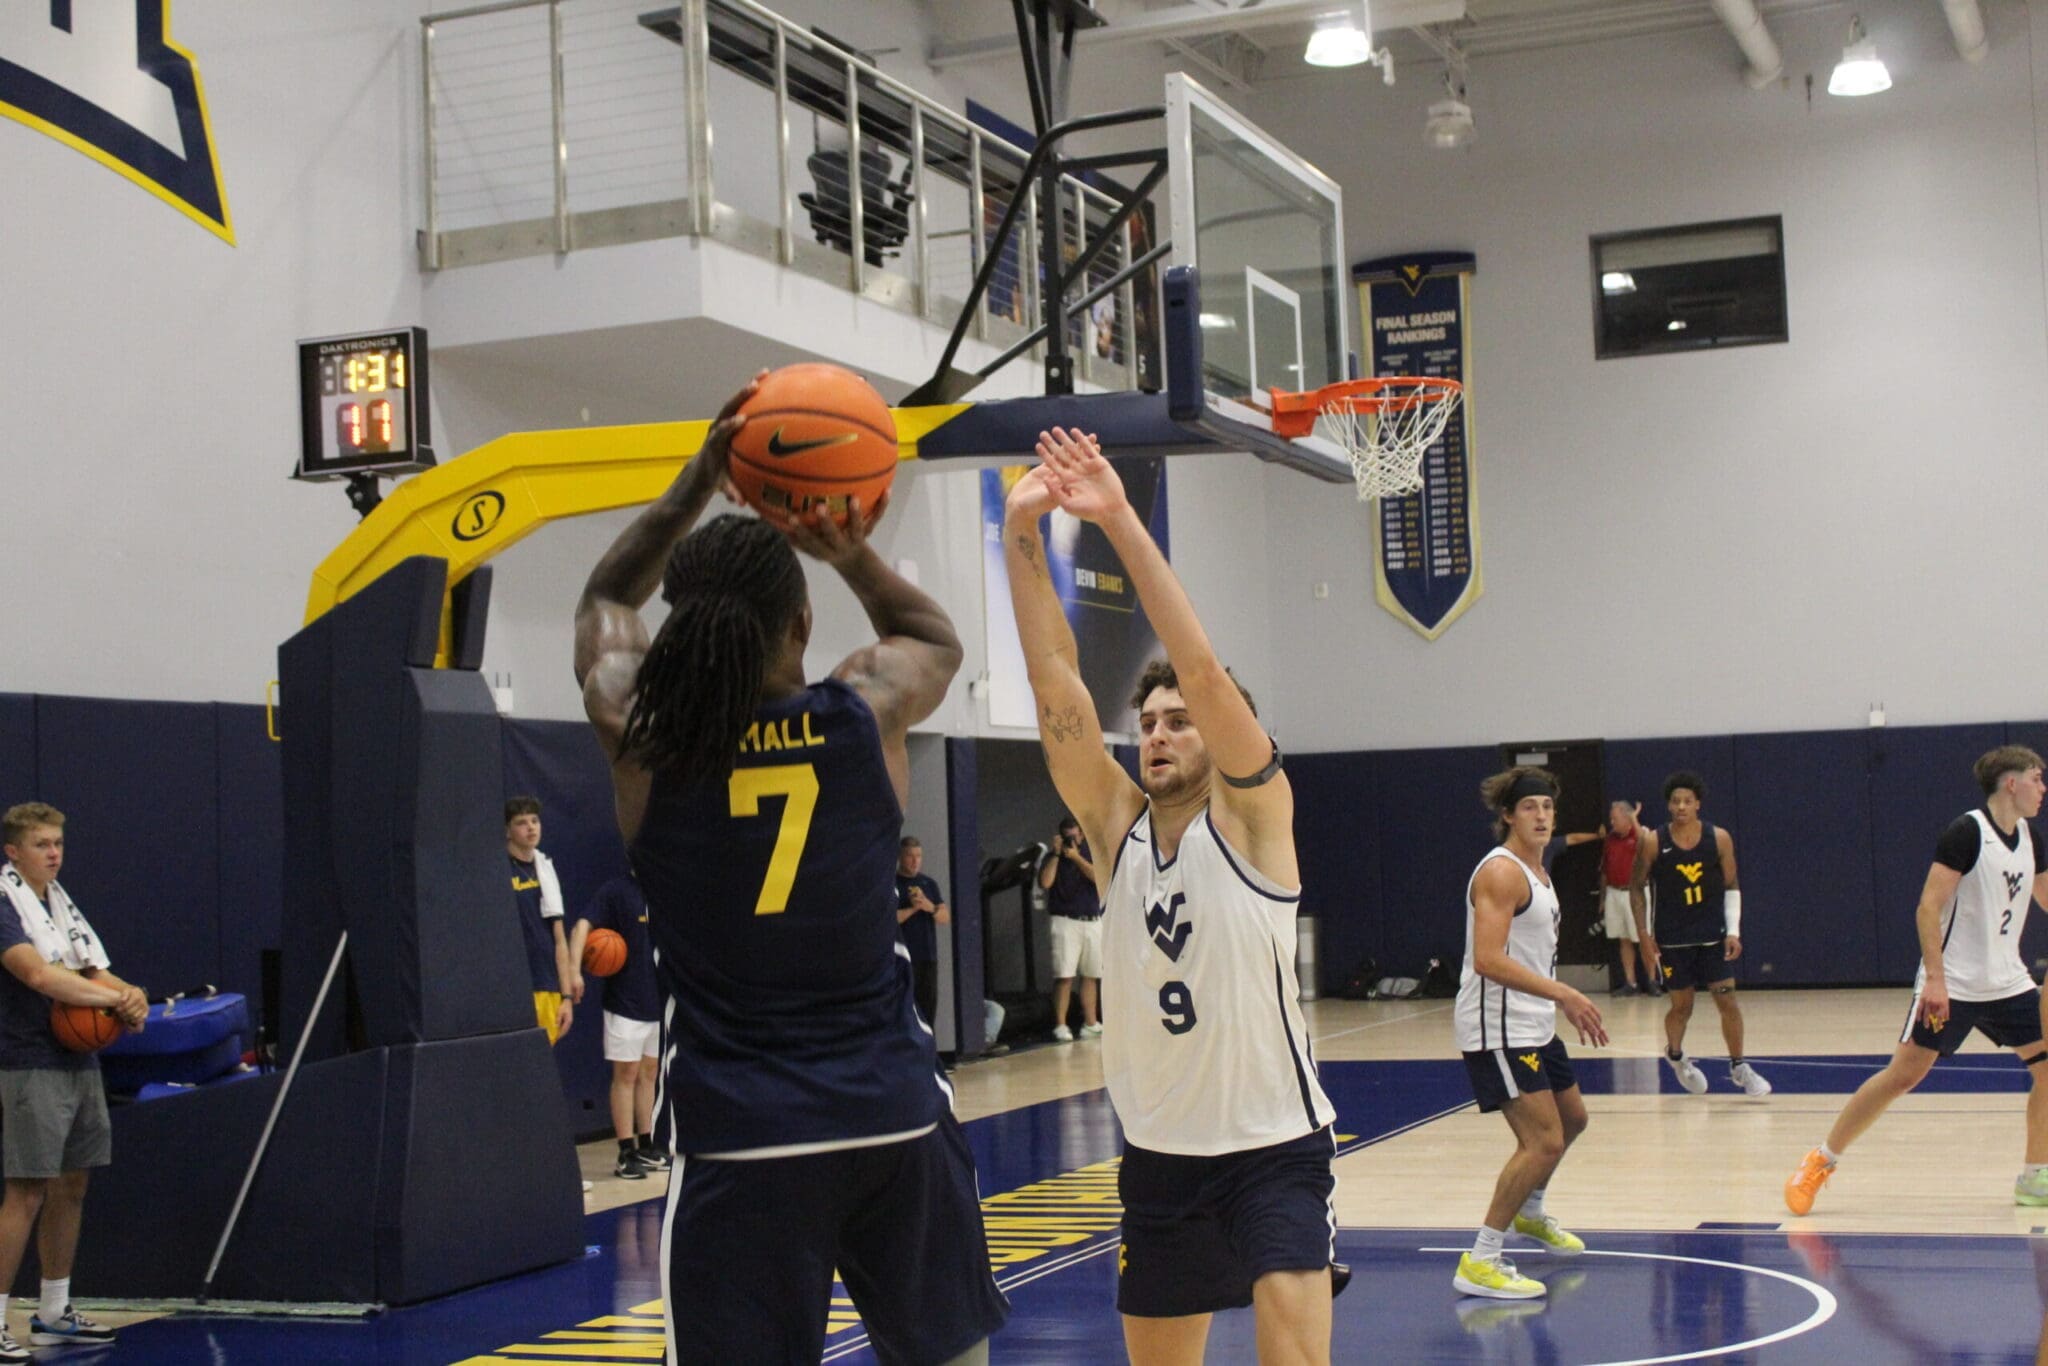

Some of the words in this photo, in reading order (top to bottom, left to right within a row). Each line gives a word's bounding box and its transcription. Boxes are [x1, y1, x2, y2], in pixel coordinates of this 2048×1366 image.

[1376, 315, 1408, 331] FINAL
[1409, 309, 1456, 327] SEASON
[320, 336, 398, 353] DAKTRONICS
[1387, 327, 1446, 344] RANKINGS
[349, 354, 405, 392] 1:31
[738, 711, 825, 752] MALL
[728, 762, 820, 916] 7
[1684, 885, 1702, 905] 11
[2000, 909, 2012, 935] 2
[1159, 981, 1197, 1035] 9
